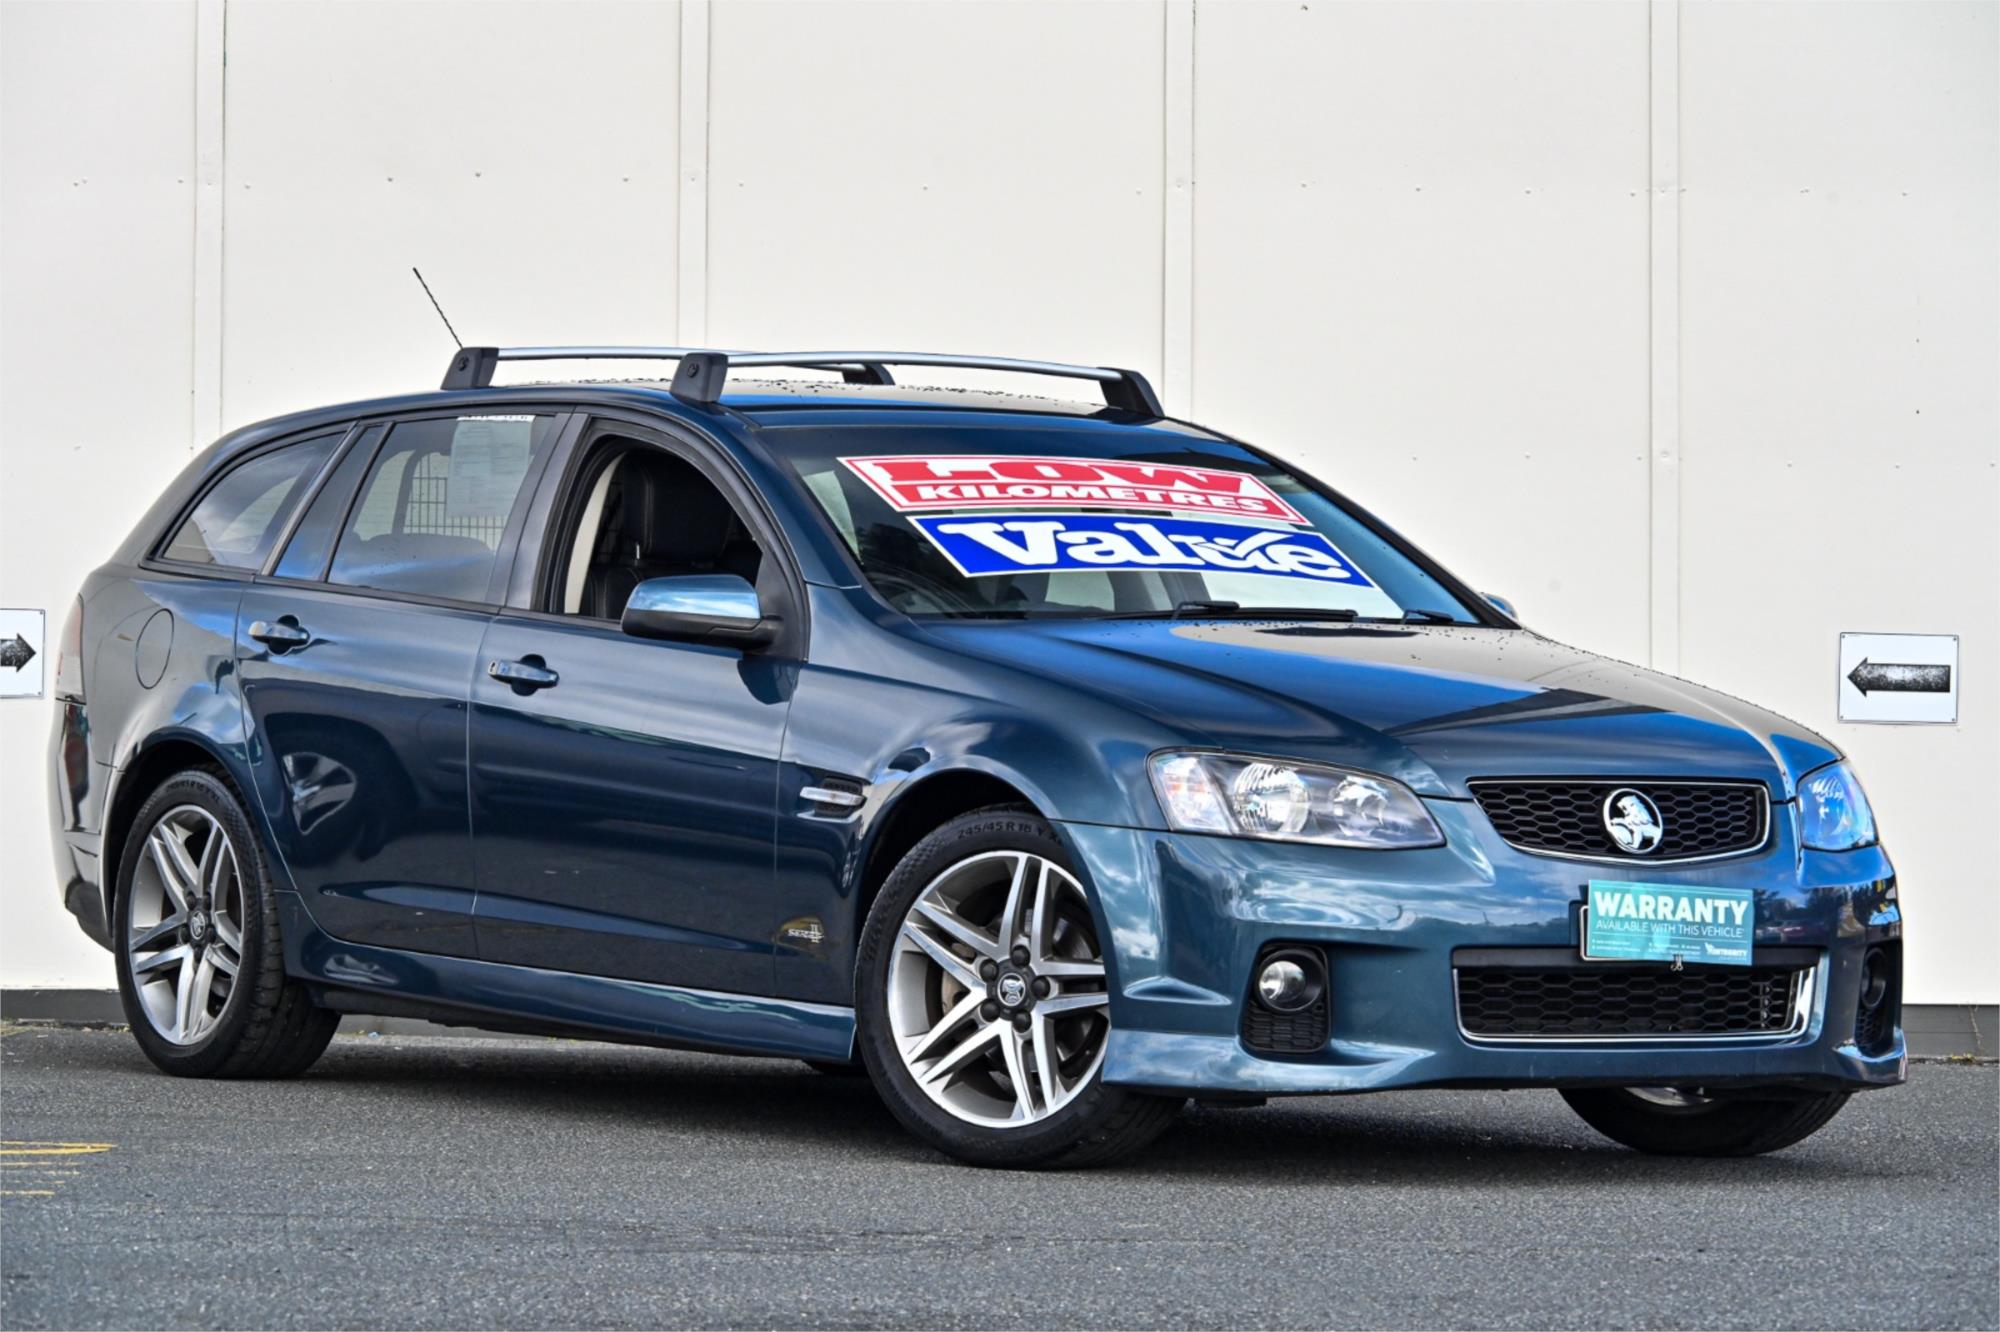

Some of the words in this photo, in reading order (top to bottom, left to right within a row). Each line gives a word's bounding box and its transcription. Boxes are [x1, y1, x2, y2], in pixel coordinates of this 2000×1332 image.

[872, 461, 1244, 494] LOW
[916, 484, 1269, 512] KILOMETRES
[936, 520, 1352, 579] Value
[1594, 891, 1749, 925] WARRANTY
[1596, 919, 1649, 932] AVAILABLE
[1651, 922, 1676, 934] WITH
[1678, 924, 1700, 936] THIS
[1701, 926, 1745, 938] VEHICLE
